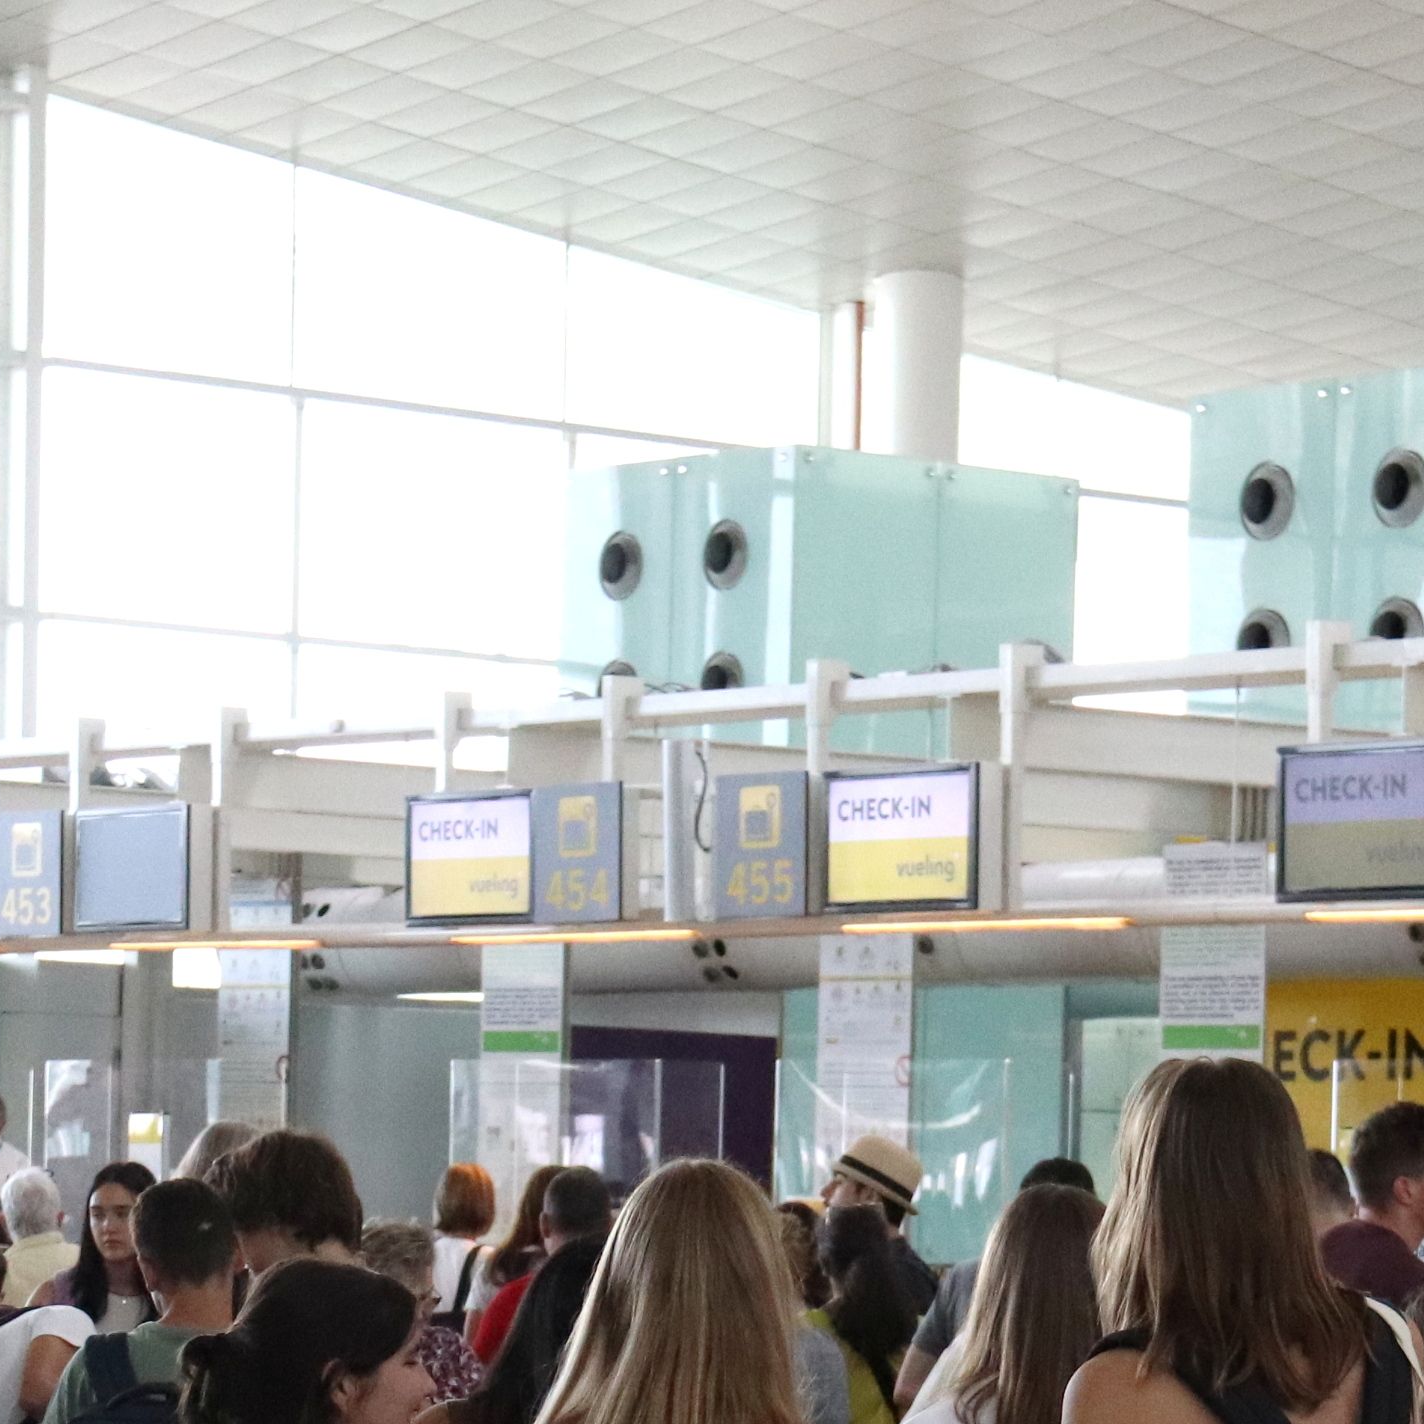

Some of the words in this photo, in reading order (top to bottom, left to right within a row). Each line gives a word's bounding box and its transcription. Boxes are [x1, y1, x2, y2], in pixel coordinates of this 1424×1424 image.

[1294, 774, 1407, 802] CHECK-IN
[838, 796, 931, 821] CHECK-IN
[418, 818, 498, 841] CHECK-IN
[896, 855, 955, 881] vueling
[470, 873, 519, 898] vueling
[545, 867, 608, 911] 454
[728, 859, 793, 905] 455
[1, 887, 50, 925] 453
